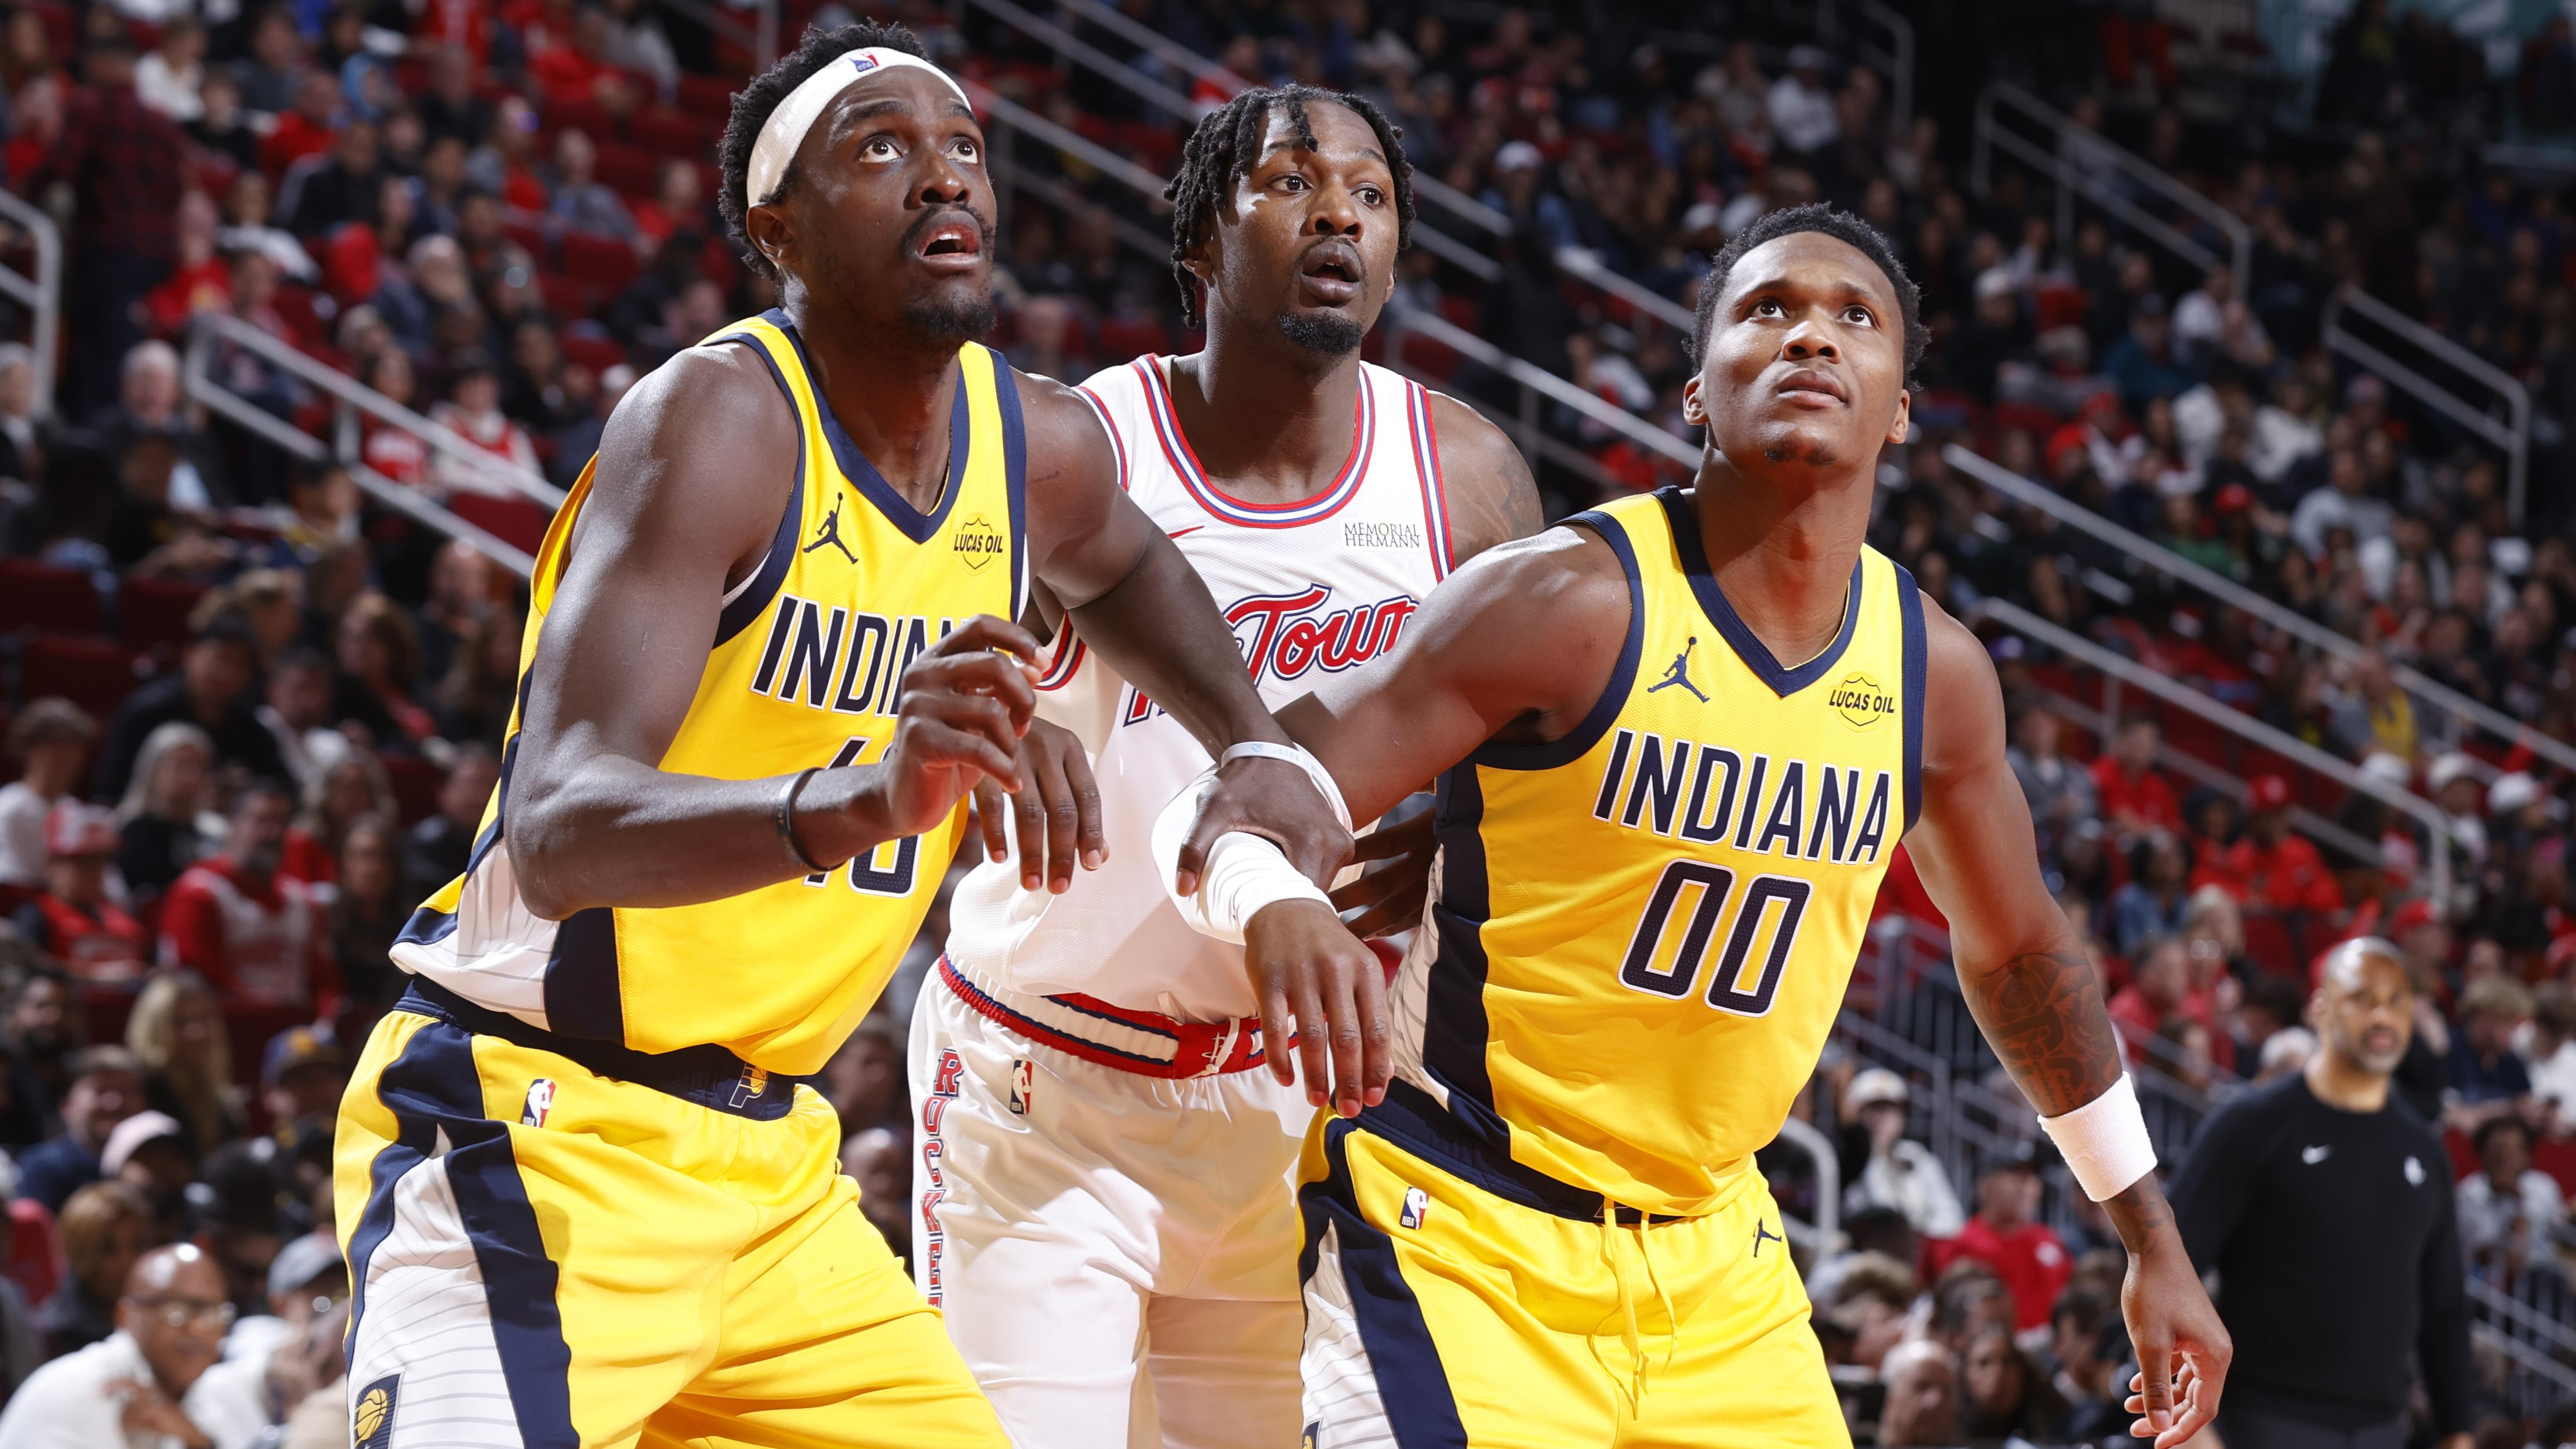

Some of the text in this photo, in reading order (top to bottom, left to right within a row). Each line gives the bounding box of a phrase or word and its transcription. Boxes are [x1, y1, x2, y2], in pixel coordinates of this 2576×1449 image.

[1344, 522, 1420, 537] MEMORIAL
[953, 533, 1003, 553] LUCAS OIL
[1344, 533, 1420, 548] HERMANN
[750, 593, 972, 719] INDIA
[1828, 689, 1895, 713] LUCAS OIL
[1591, 726, 1892, 865] INDIANA
[1618, 857, 1813, 1019] 00
[1011, 1102, 1022, 1112] NBA
[1401, 1215, 1414, 1227] NBA
